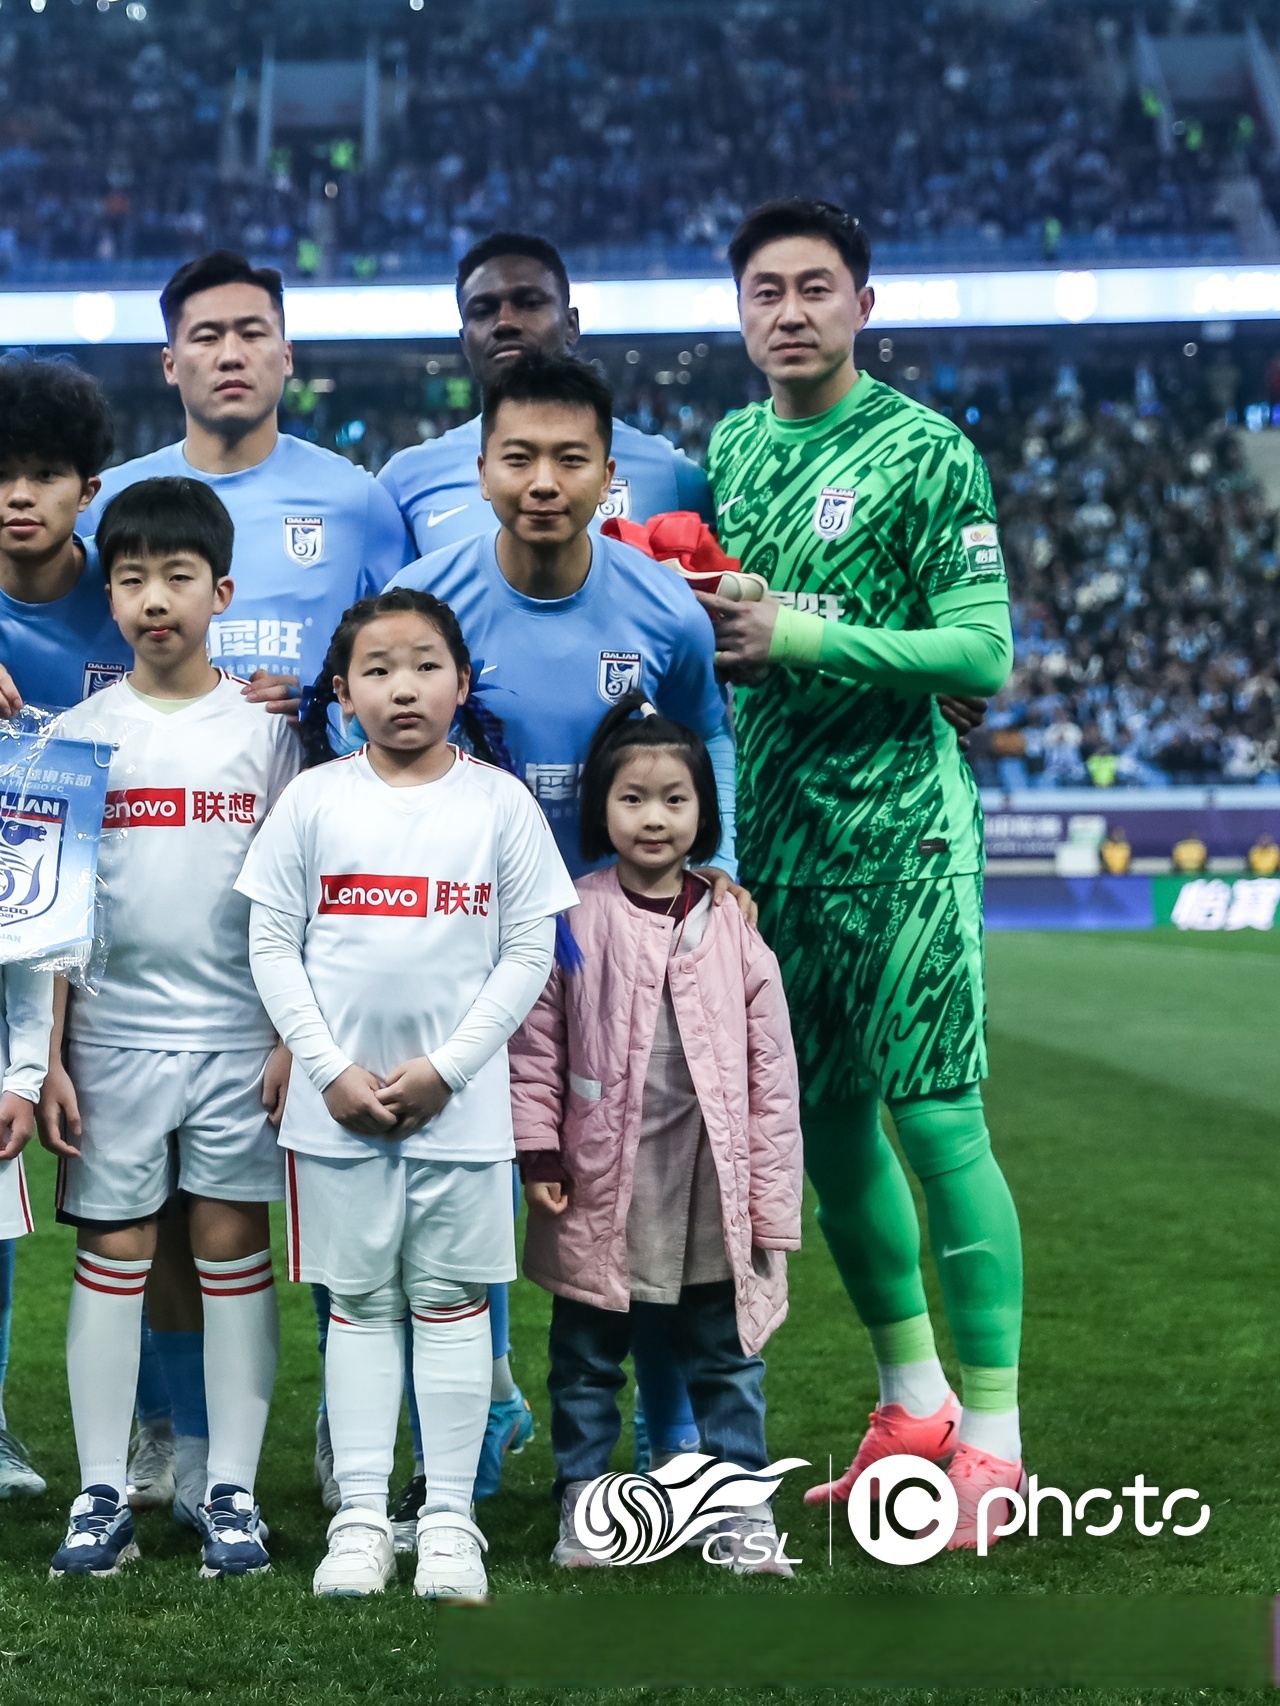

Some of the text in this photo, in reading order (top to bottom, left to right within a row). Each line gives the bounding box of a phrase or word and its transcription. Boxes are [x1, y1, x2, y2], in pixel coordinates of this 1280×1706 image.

[769, 589, 846, 623] 旺
[602, 652, 639, 660] DALIAN
[87, 662, 122, 671] DALIAN
[50, 784, 64, 793] FC
[104, 800, 177, 819] enovo
[192, 791, 257, 824] 联想
[324, 884, 418, 907] Lenovo
